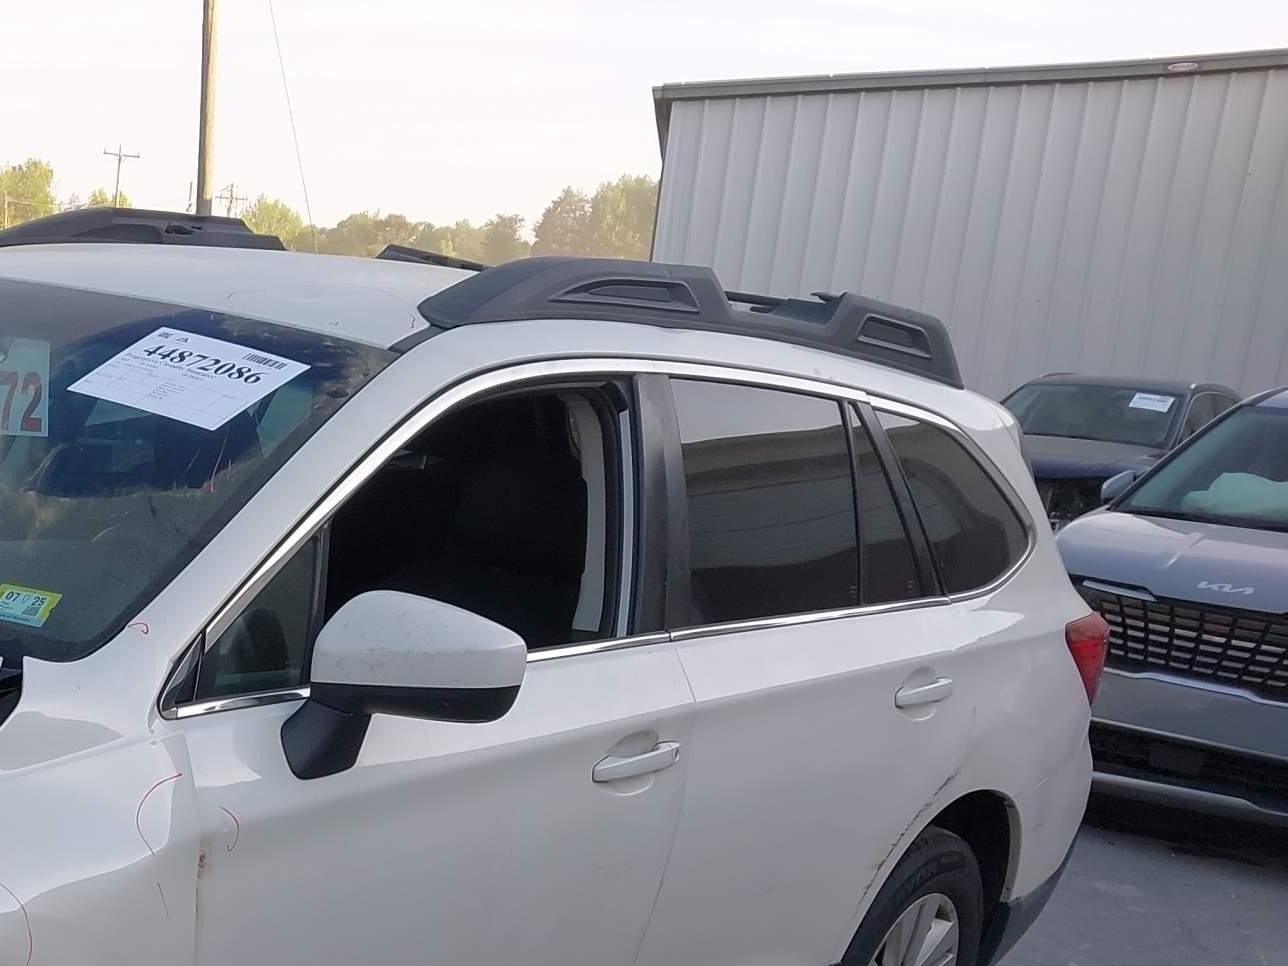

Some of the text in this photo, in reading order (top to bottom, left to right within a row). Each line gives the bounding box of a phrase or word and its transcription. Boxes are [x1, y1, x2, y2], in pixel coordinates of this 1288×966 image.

[143, 345, 270, 385] 44872086
[5, 591, 48, 607] 07 25
